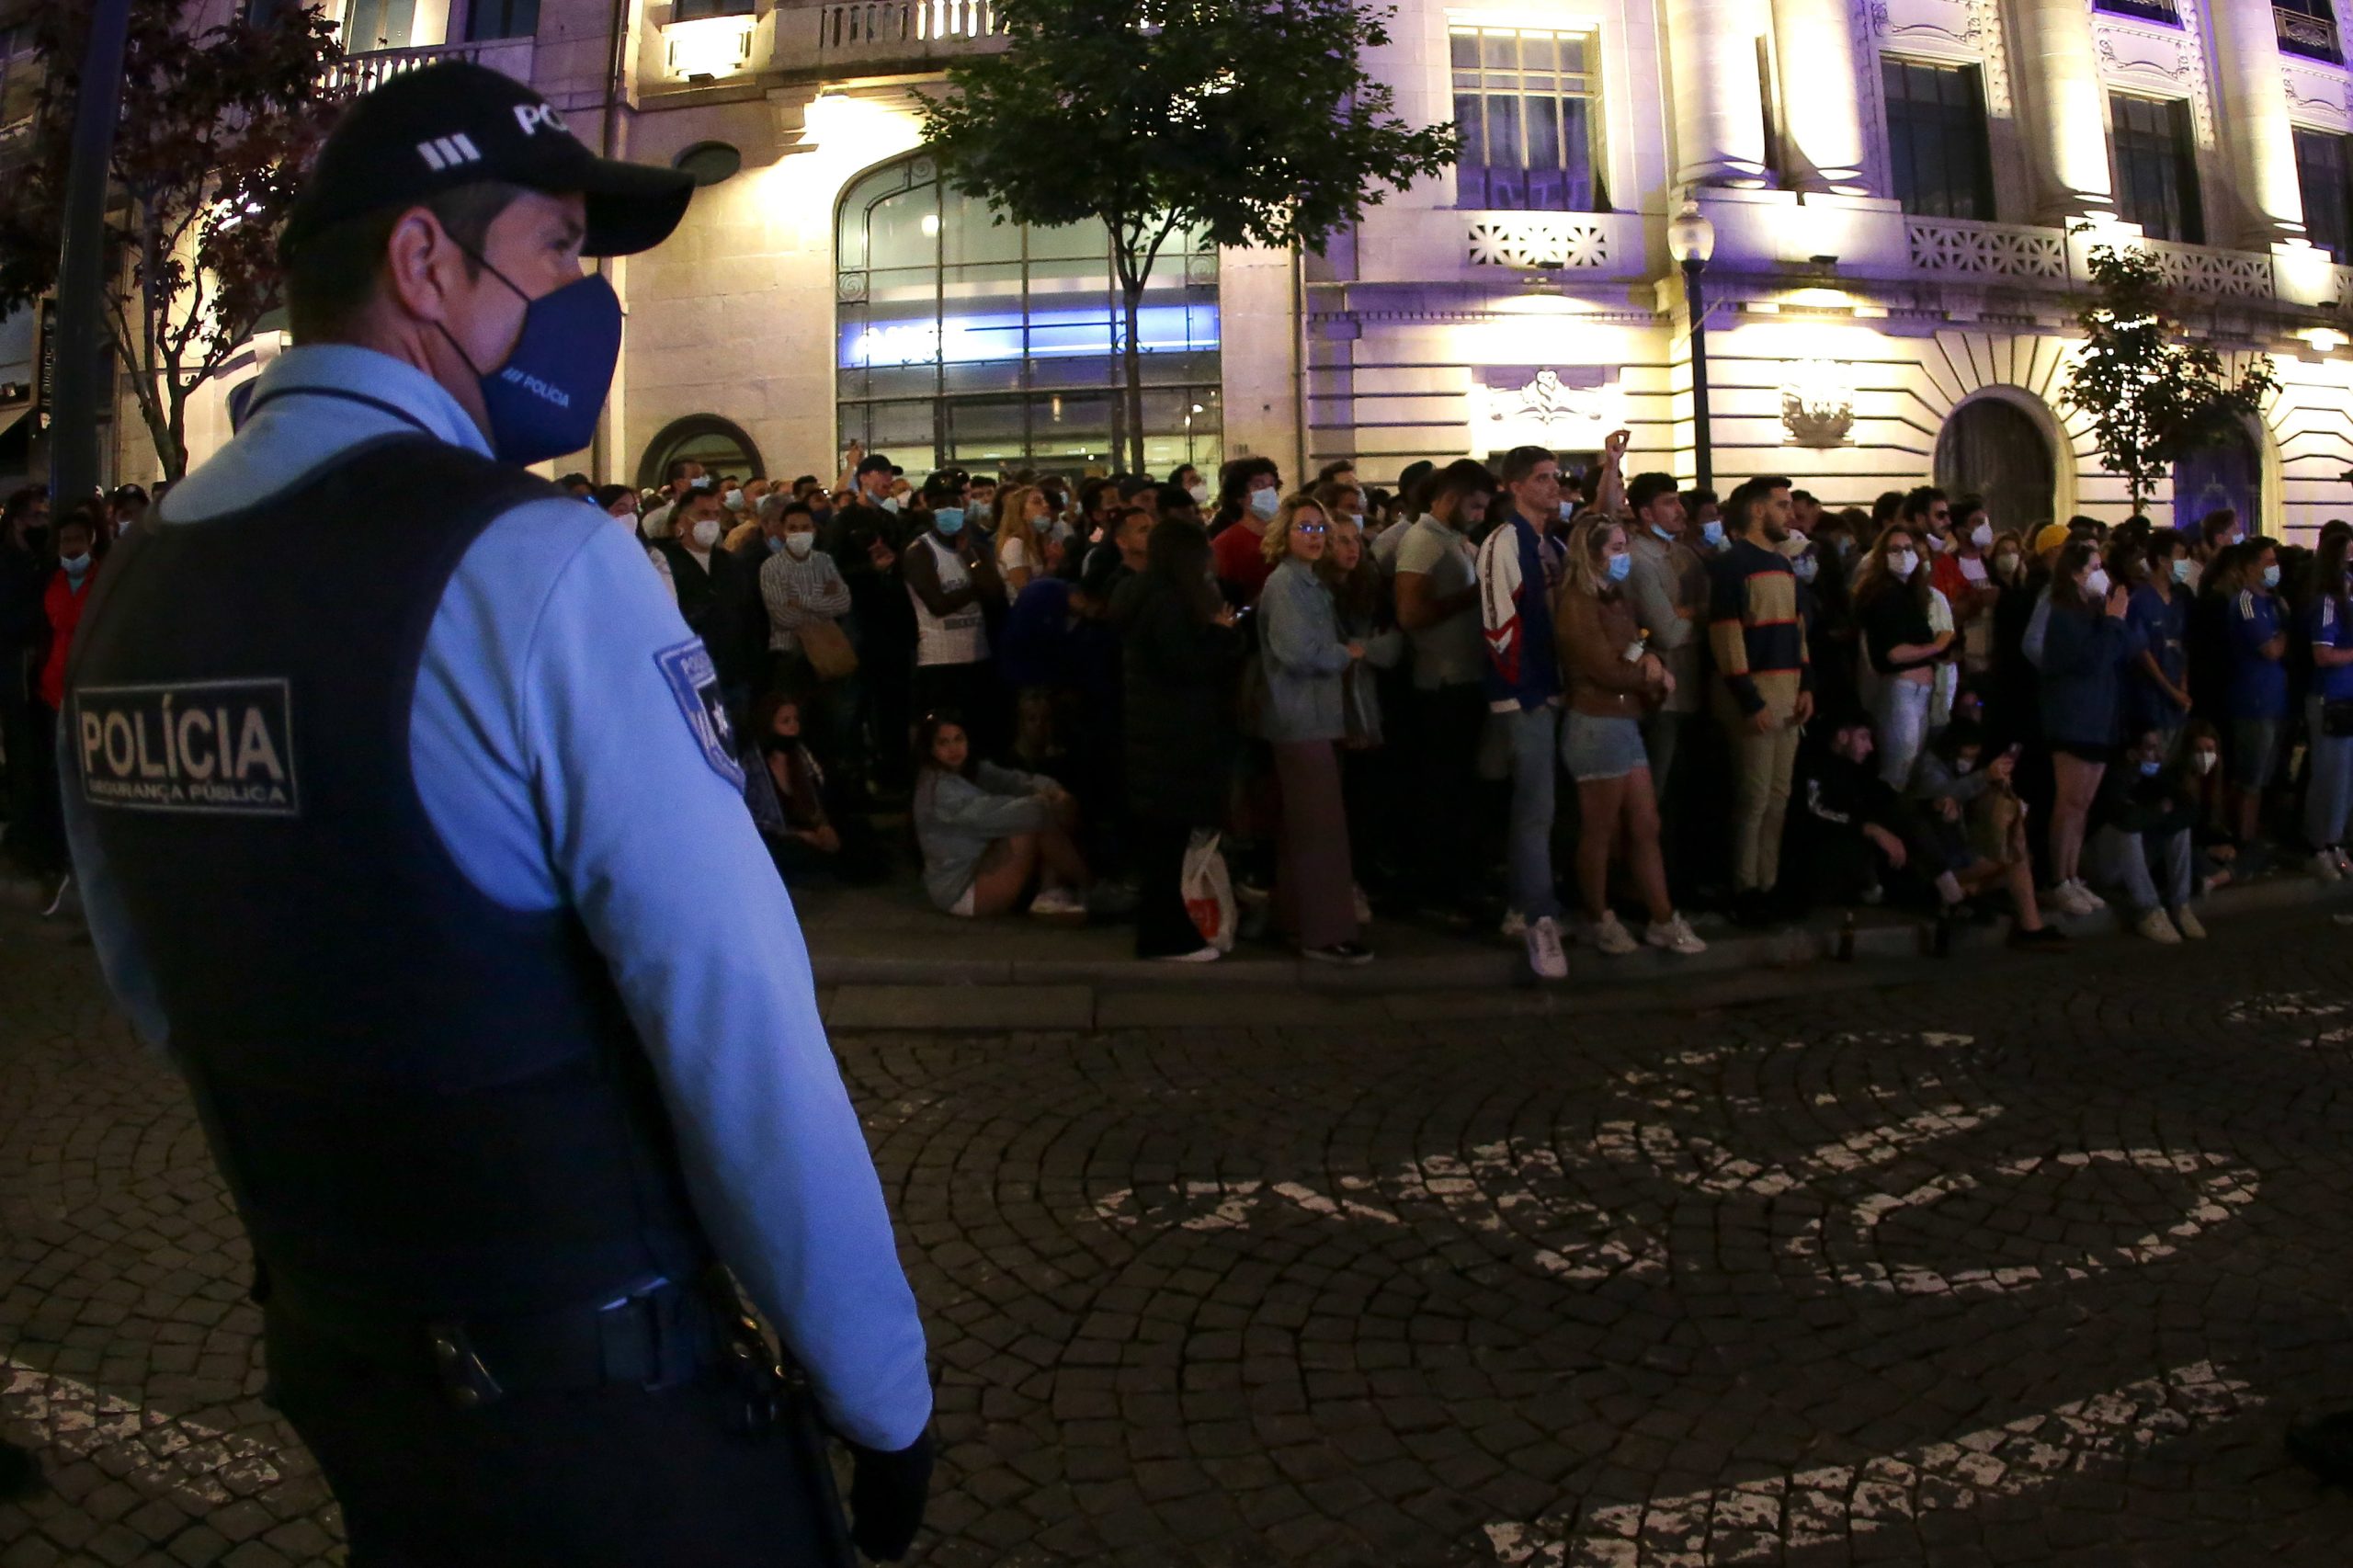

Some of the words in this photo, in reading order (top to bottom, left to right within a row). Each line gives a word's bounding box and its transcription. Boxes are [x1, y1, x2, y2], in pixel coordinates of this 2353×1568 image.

[523, 374, 570, 407] POLÍCIA
[81, 692, 285, 780] POLÍCIA
[188, 779, 287, 803] PÚBLICA
